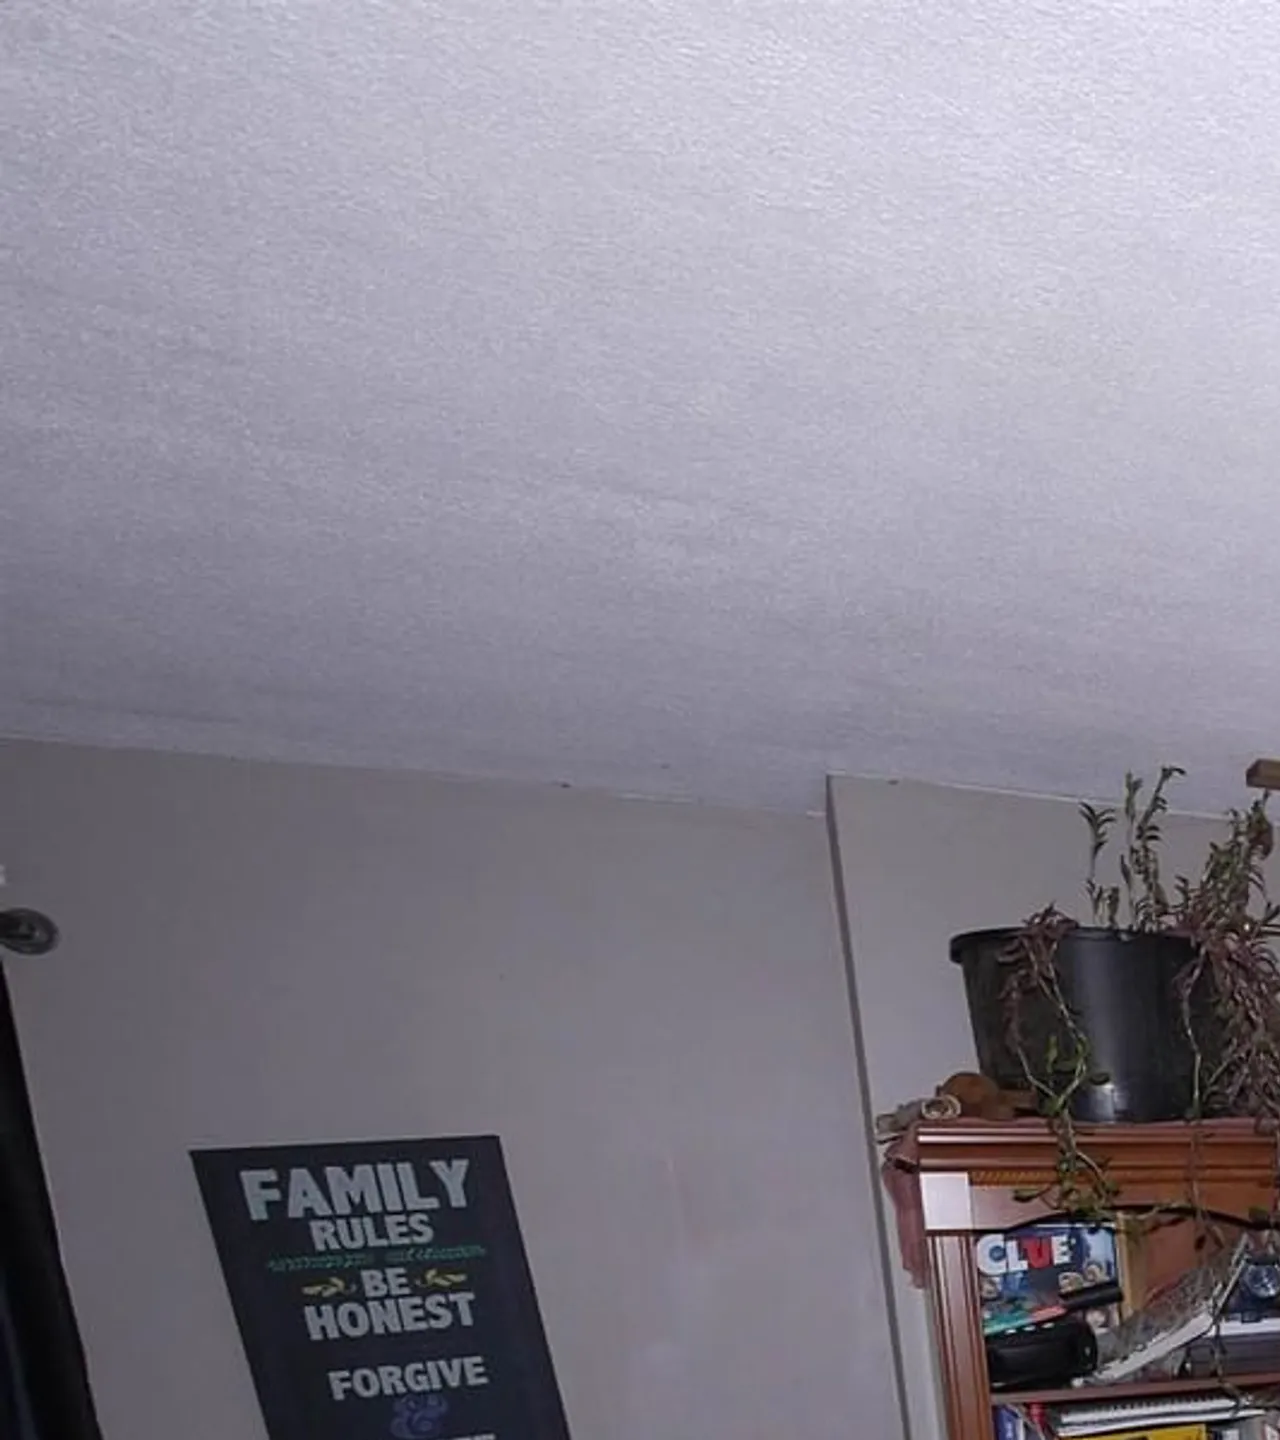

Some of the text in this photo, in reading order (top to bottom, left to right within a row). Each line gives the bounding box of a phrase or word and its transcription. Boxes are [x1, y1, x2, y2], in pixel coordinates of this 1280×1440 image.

[238, 1158, 470, 1221] FAMILY
[309, 1213, 435, 1252] RULES
[976, 1233, 1072, 1275] CLUE
[360, 1267, 411, 1299] BE
[303, 1291, 475, 1341] HONEST
[327, 1354, 490, 1401] FORGIVE
